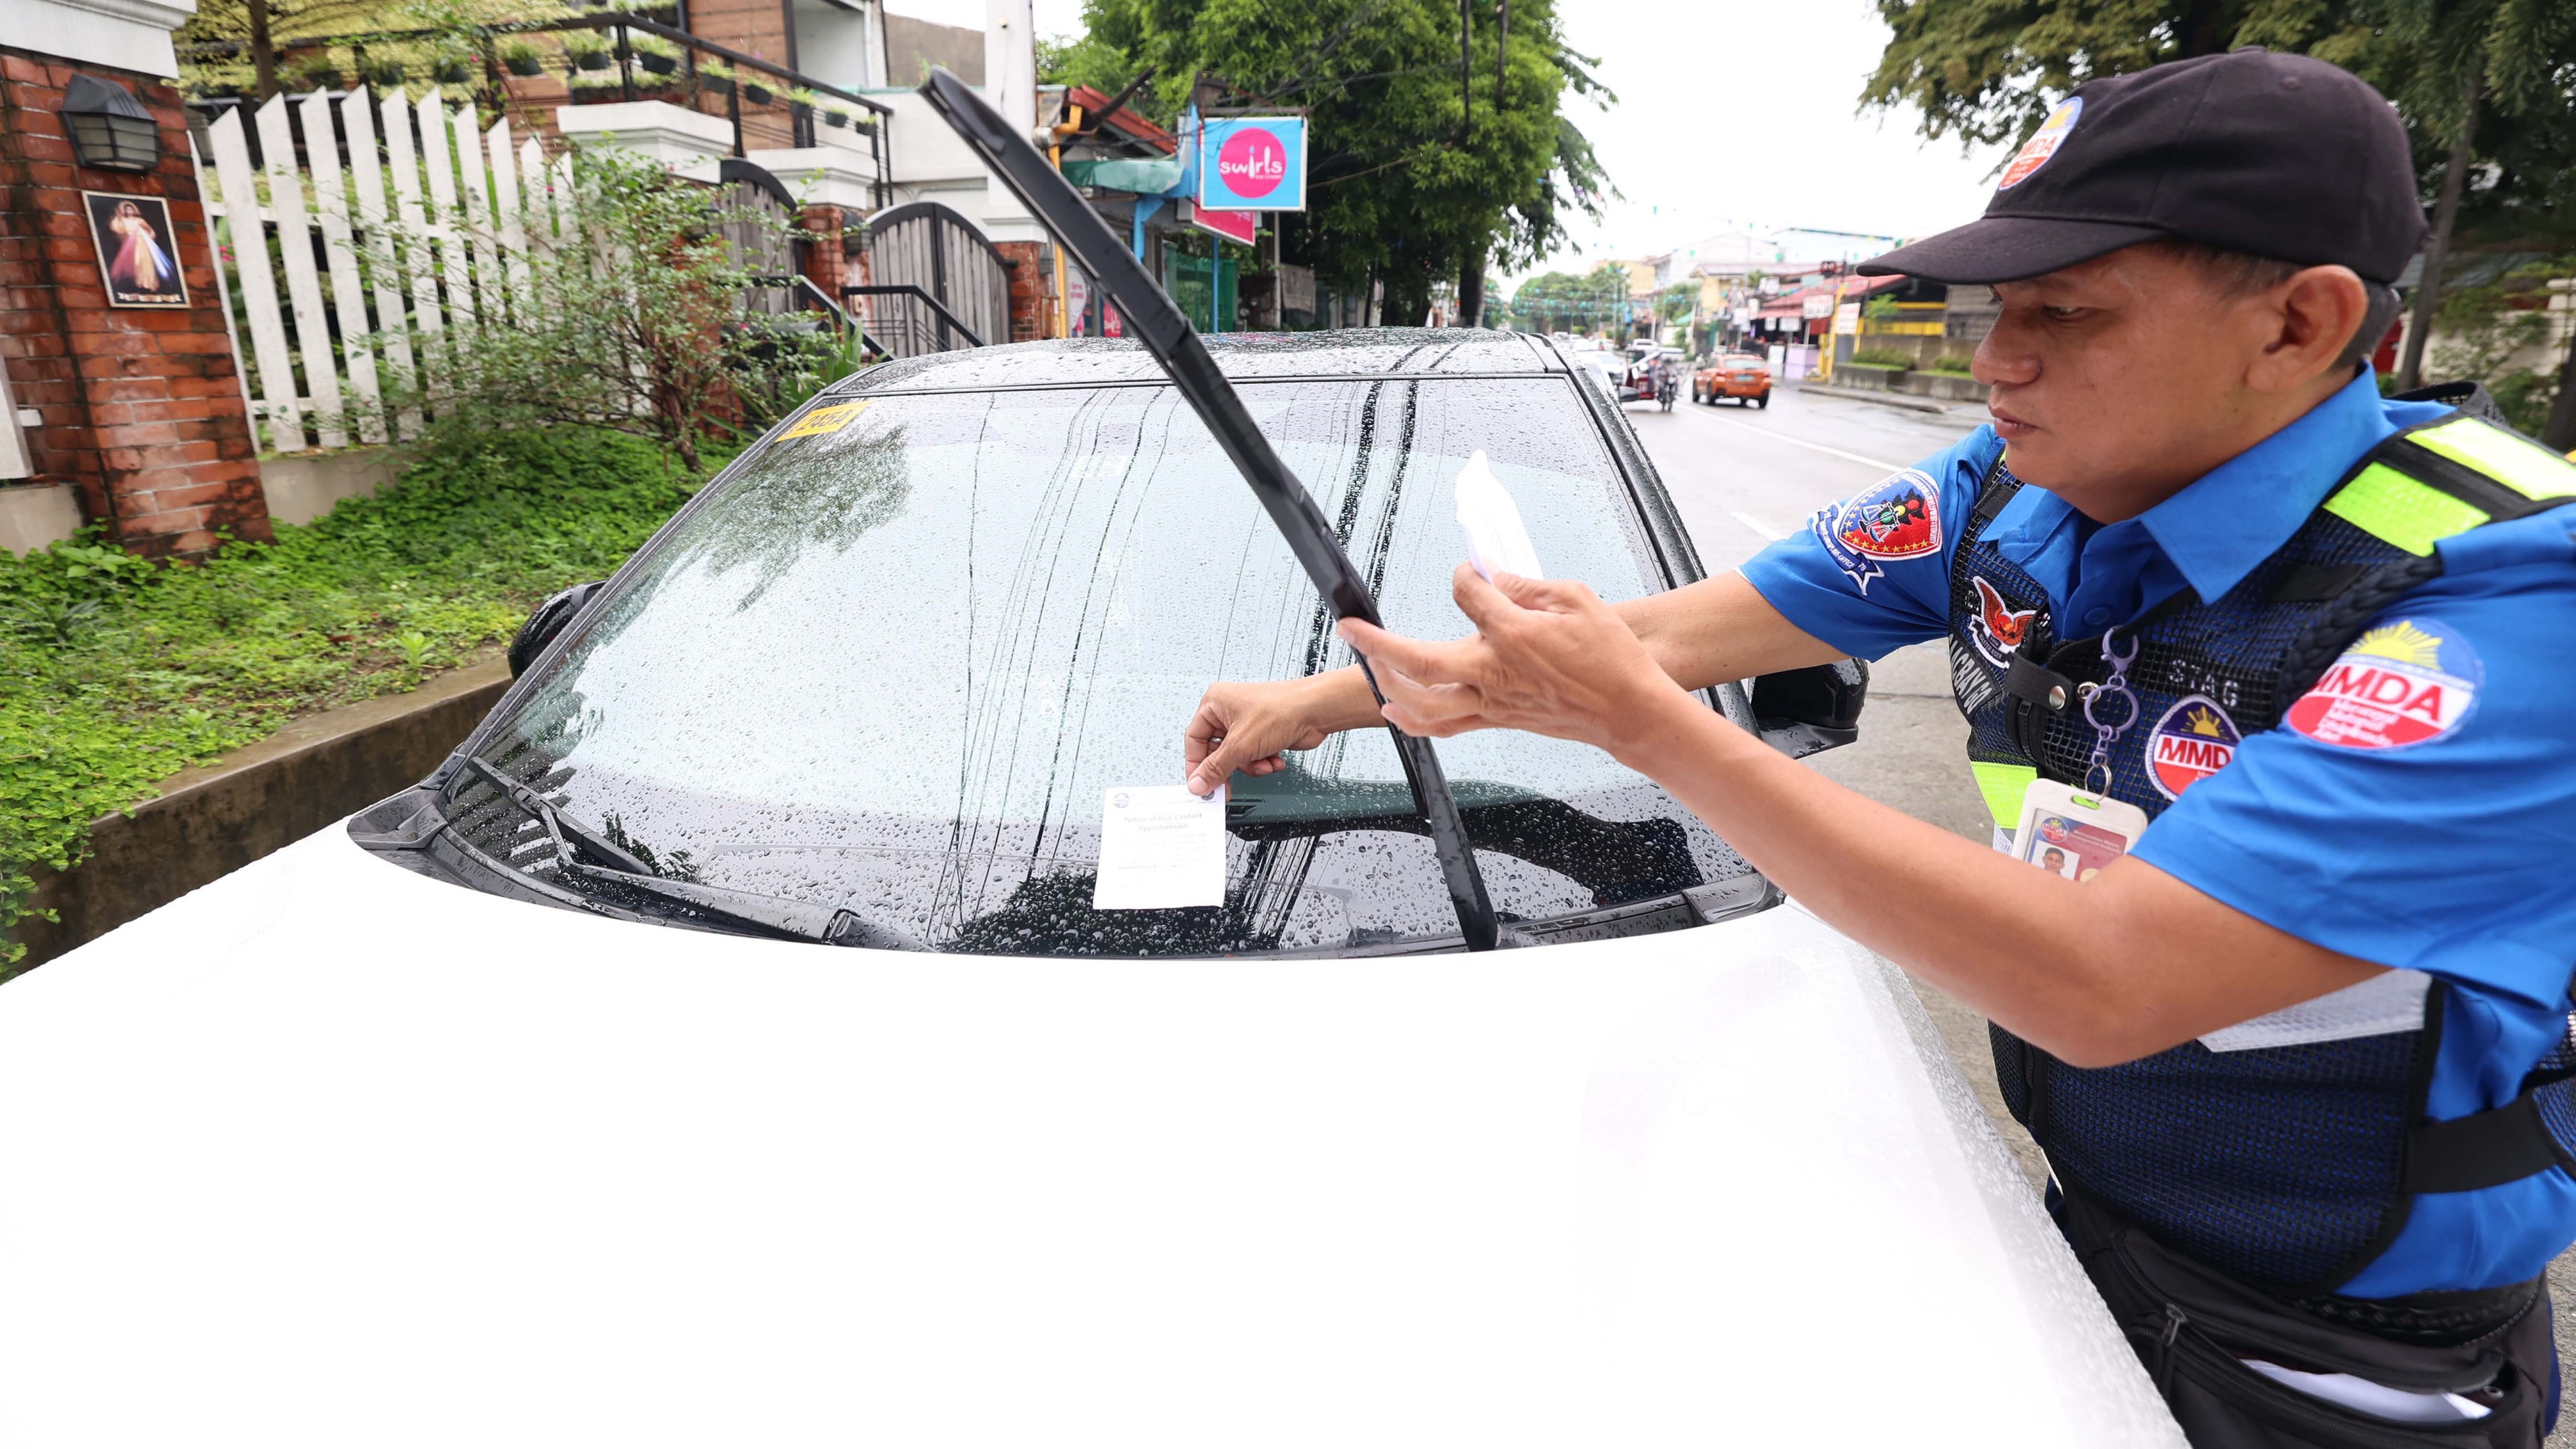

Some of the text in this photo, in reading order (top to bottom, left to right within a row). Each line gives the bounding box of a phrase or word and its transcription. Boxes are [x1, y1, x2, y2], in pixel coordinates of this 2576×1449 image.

[1219, 145, 1283, 178] swirls
[1979, 633, 1992, 652] MASTER
[2159, 737, 2231, 769] MMD
[1138, 823, 1188, 833] Apprehension
